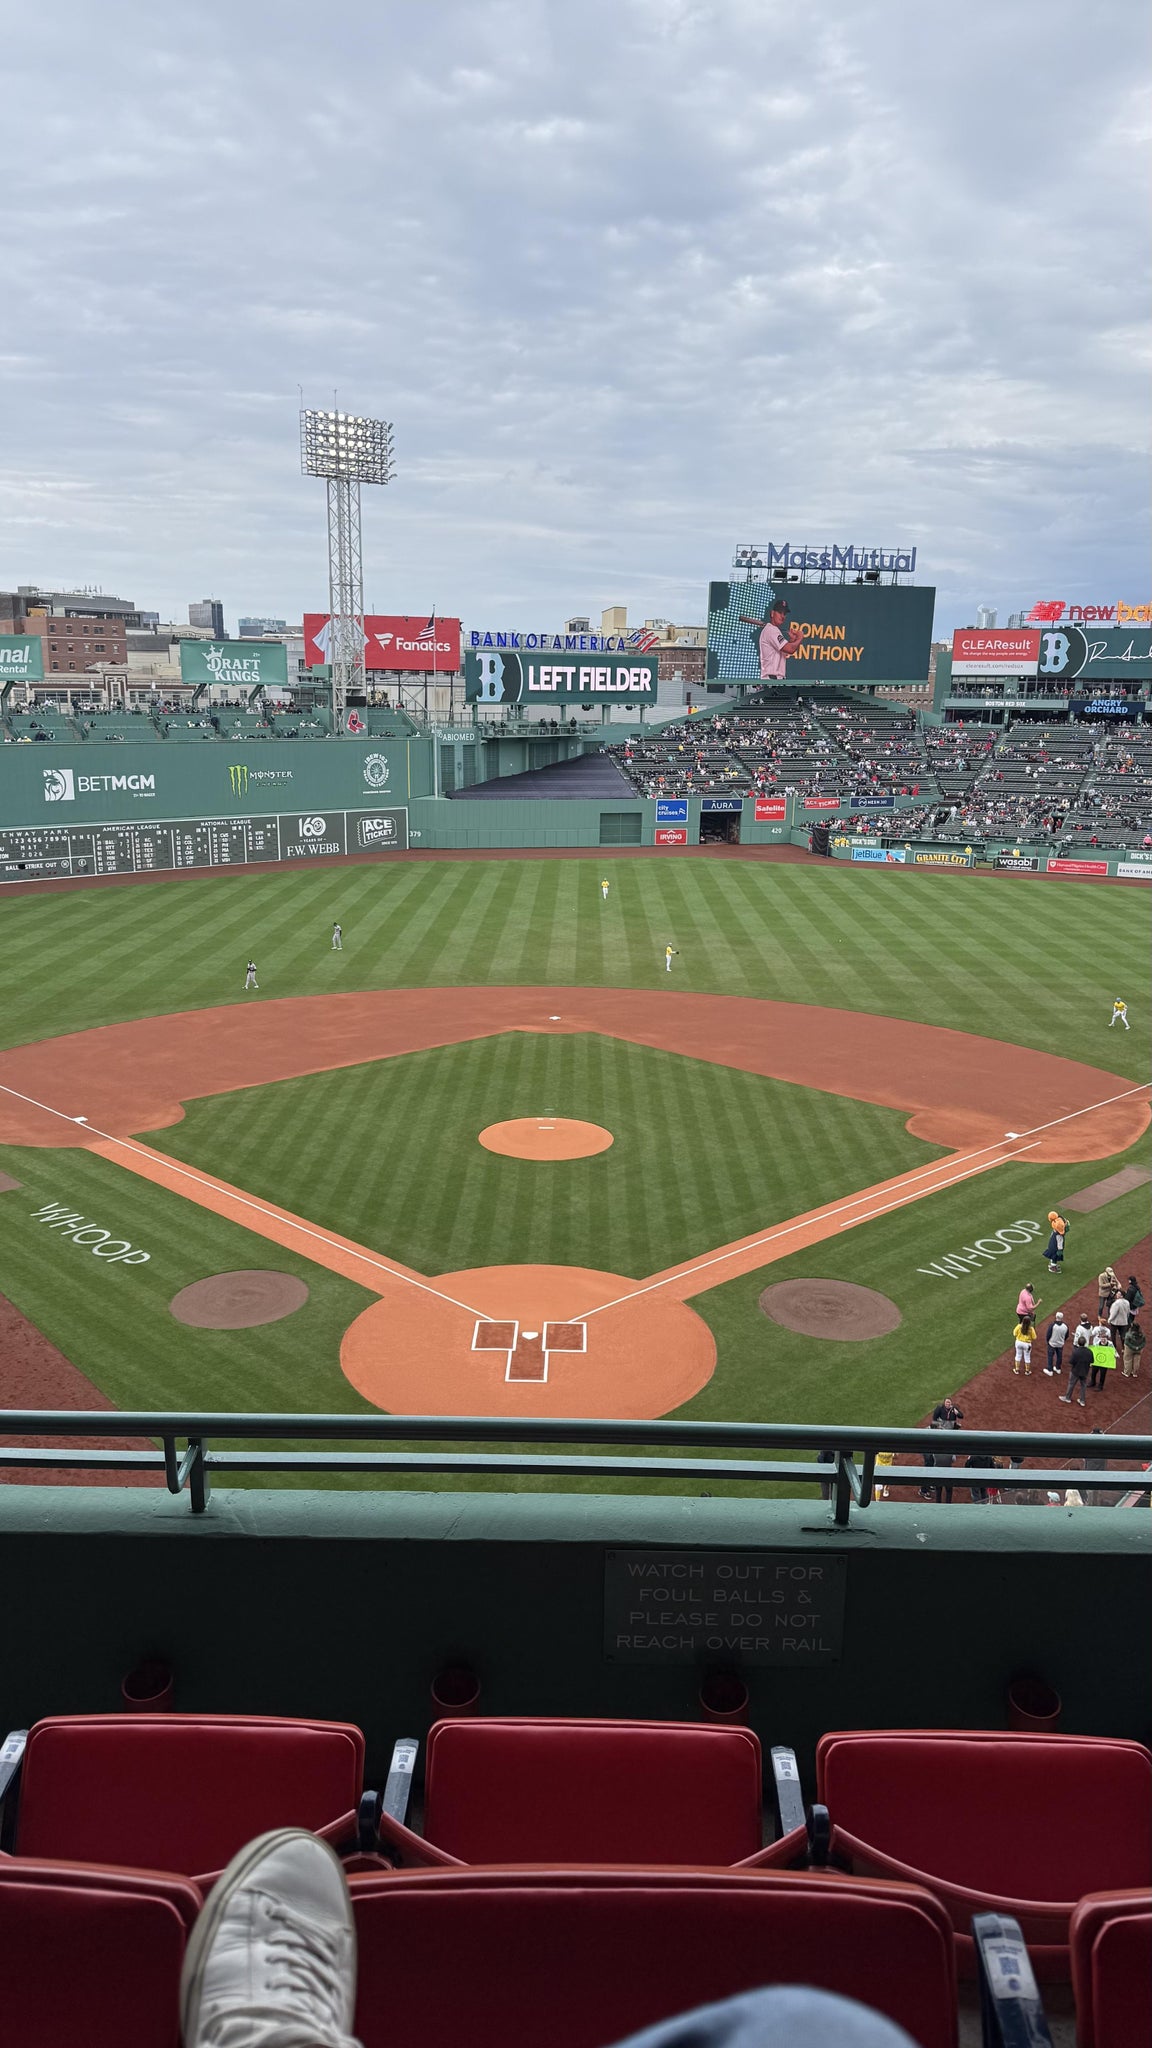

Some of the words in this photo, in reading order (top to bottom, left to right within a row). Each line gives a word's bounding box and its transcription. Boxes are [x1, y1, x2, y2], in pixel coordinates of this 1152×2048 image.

[768, 542, 917, 572] MassMutual
[1069, 605, 1115, 620] new
[396, 637, 451, 652] Fanatics
[471, 631, 521, 648] BANK
[526, 633, 547, 649] OF
[553, 635, 625, 651] AMERICA
[962, 640, 1031, 649] CLEAResult
[0, 665, 27, 673] Rental
[207, 658, 260, 672] DRAFT
[215, 669, 260, 681] KINGS
[528, 665, 576, 691] LEFT
[579, 667, 652, 692] FIELDER
[442, 733, 475, 741] ABIOMED
[250, 770, 293, 779] MONSTER
[78, 775, 155, 792] BETMGM
[365, 819, 392, 832] ACE
[366, 829, 392, 840] TICKET
[287, 845, 306, 856] F.W.
[308, 843, 339, 854] WEBB
[855, 850, 882, 859] jetBlue
[916, 854, 948, 862] GRANITE
[950, 853, 968, 865] CITY
[30, 1202, 150, 1264] WHOOP
[917, 1220, 1044, 1279] WHOOP
[628, 1563, 704, 1578] WATCH
[716, 1565, 764, 1579] OUT
[776, 1567, 824, 1580] FOR
[639, 1588, 702, 1602] FOUL
[713, 1590, 785, 1603] BALLS
[798, 1590, 812, 1604] &
[630, 1612, 718, 1626] PLEASE
[730, 1613, 762, 1627] DO
[775, 1615, 820, 1627] NOT
[616, 1635, 694, 1649] REACH
[706, 1636, 769, 1650] OVER
[782, 1638, 831, 1651] RAIL
